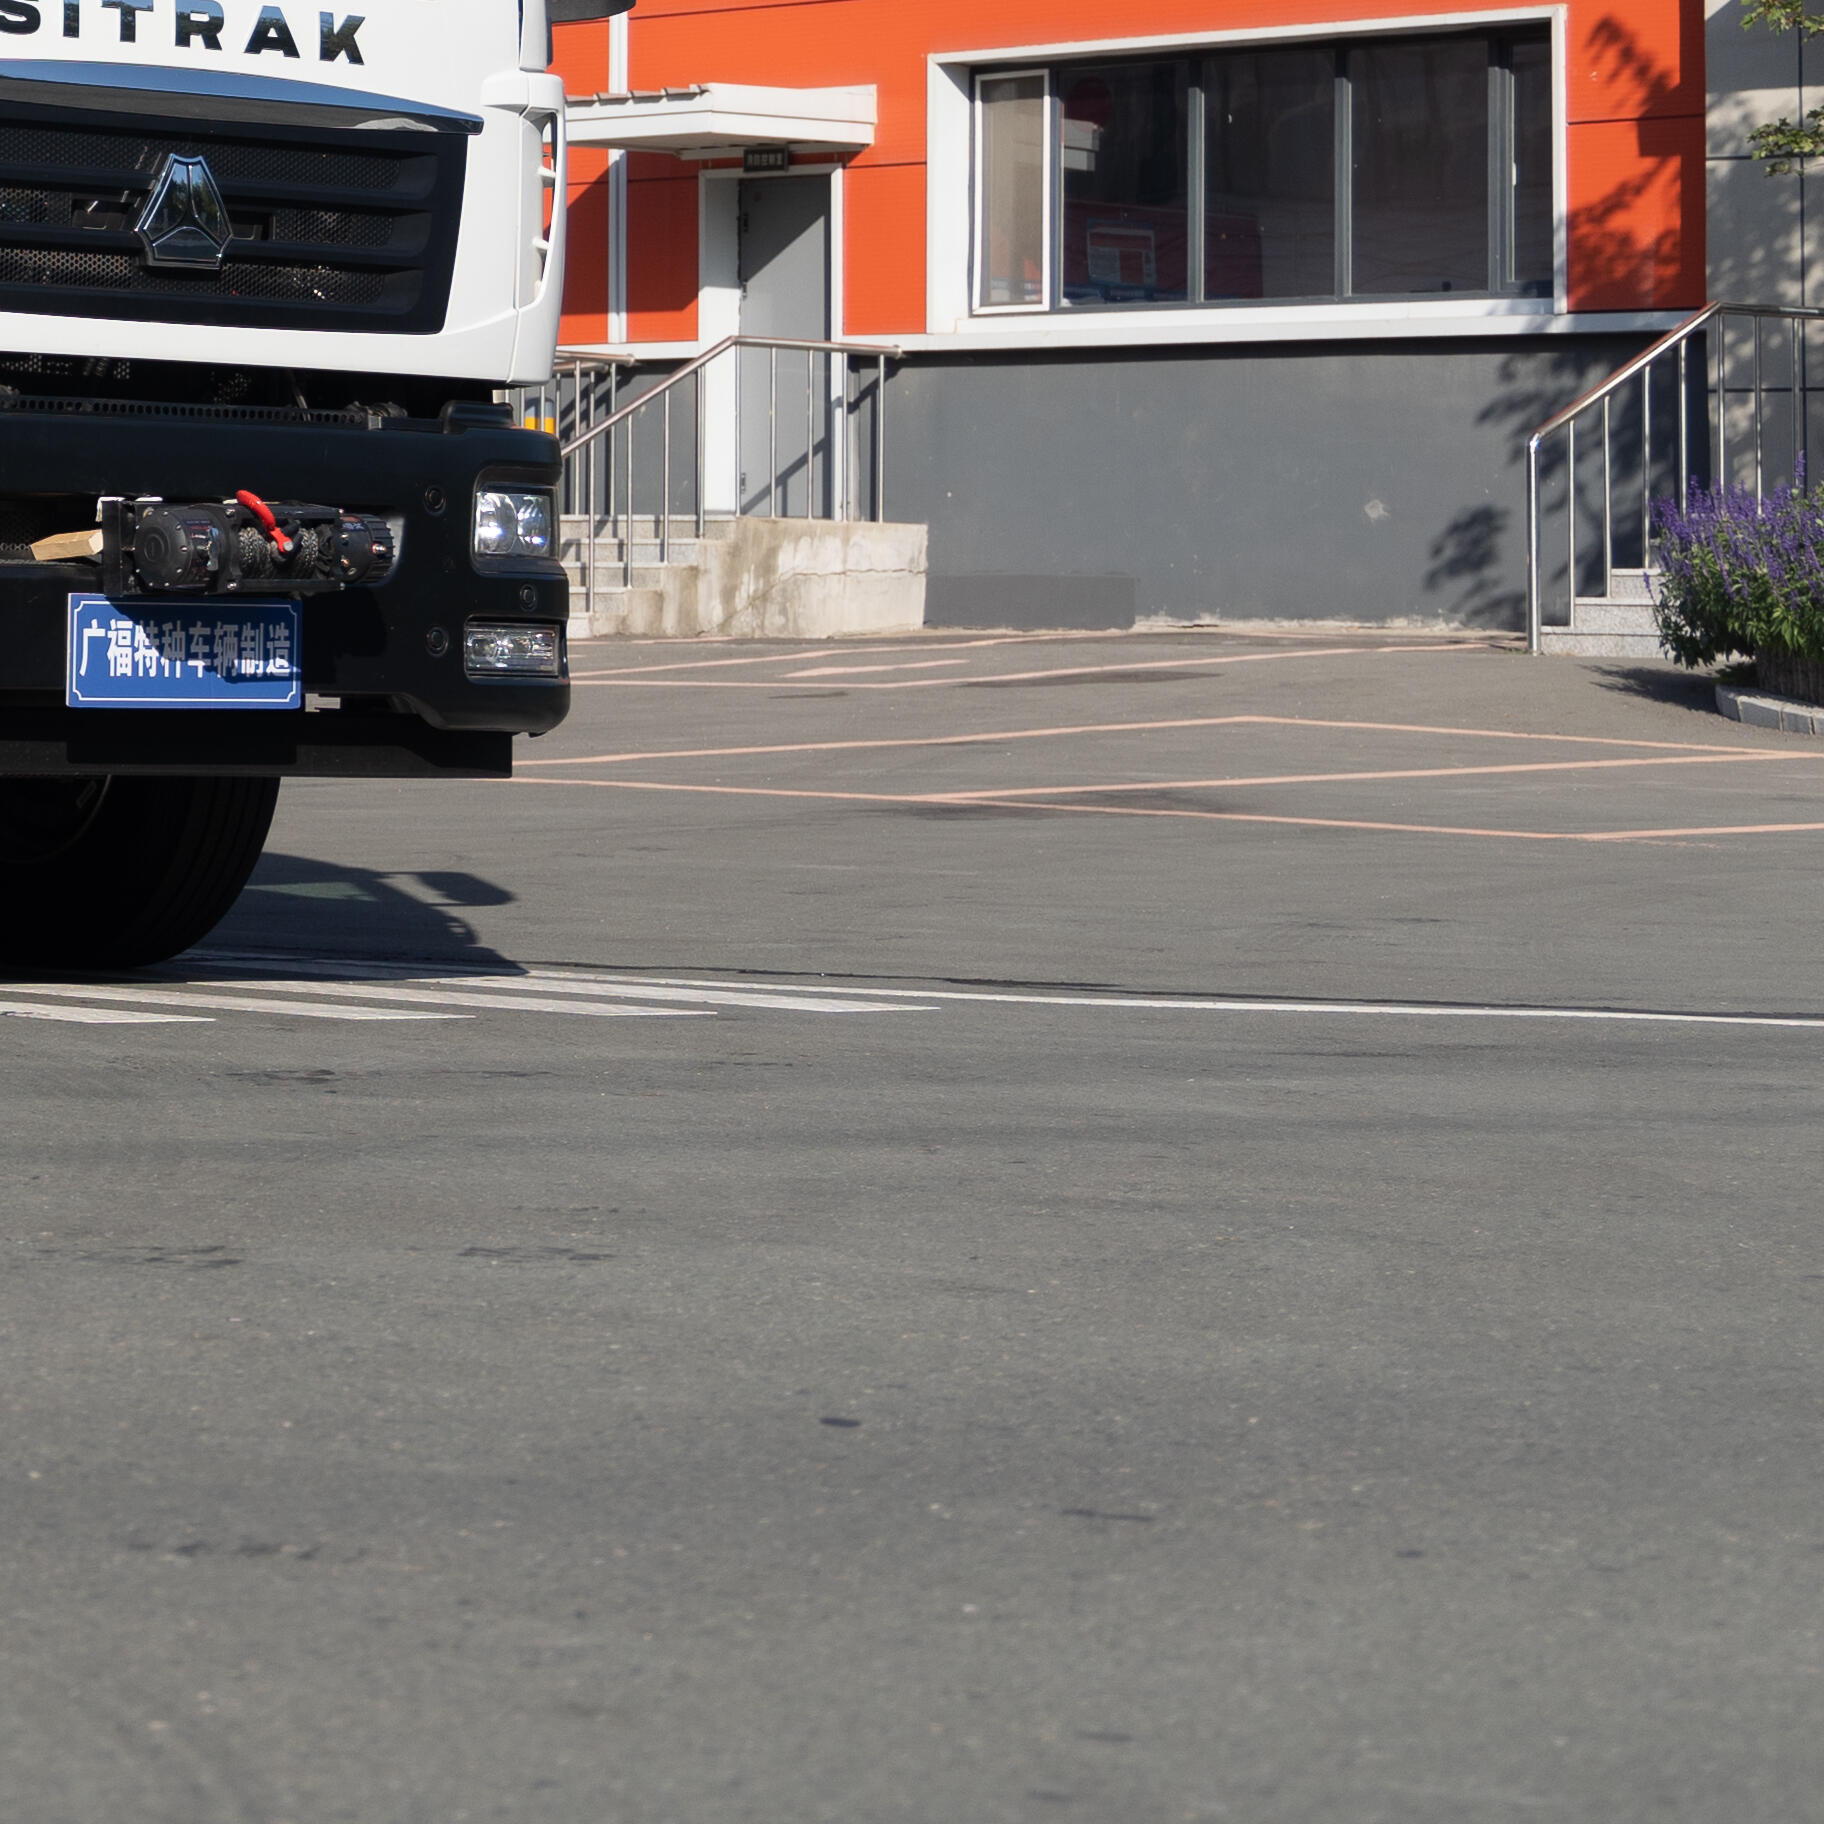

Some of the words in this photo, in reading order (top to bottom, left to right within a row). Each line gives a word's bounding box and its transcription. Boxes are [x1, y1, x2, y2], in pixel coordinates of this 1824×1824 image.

[79, 618, 291, 679] 广福特种车辆制造
